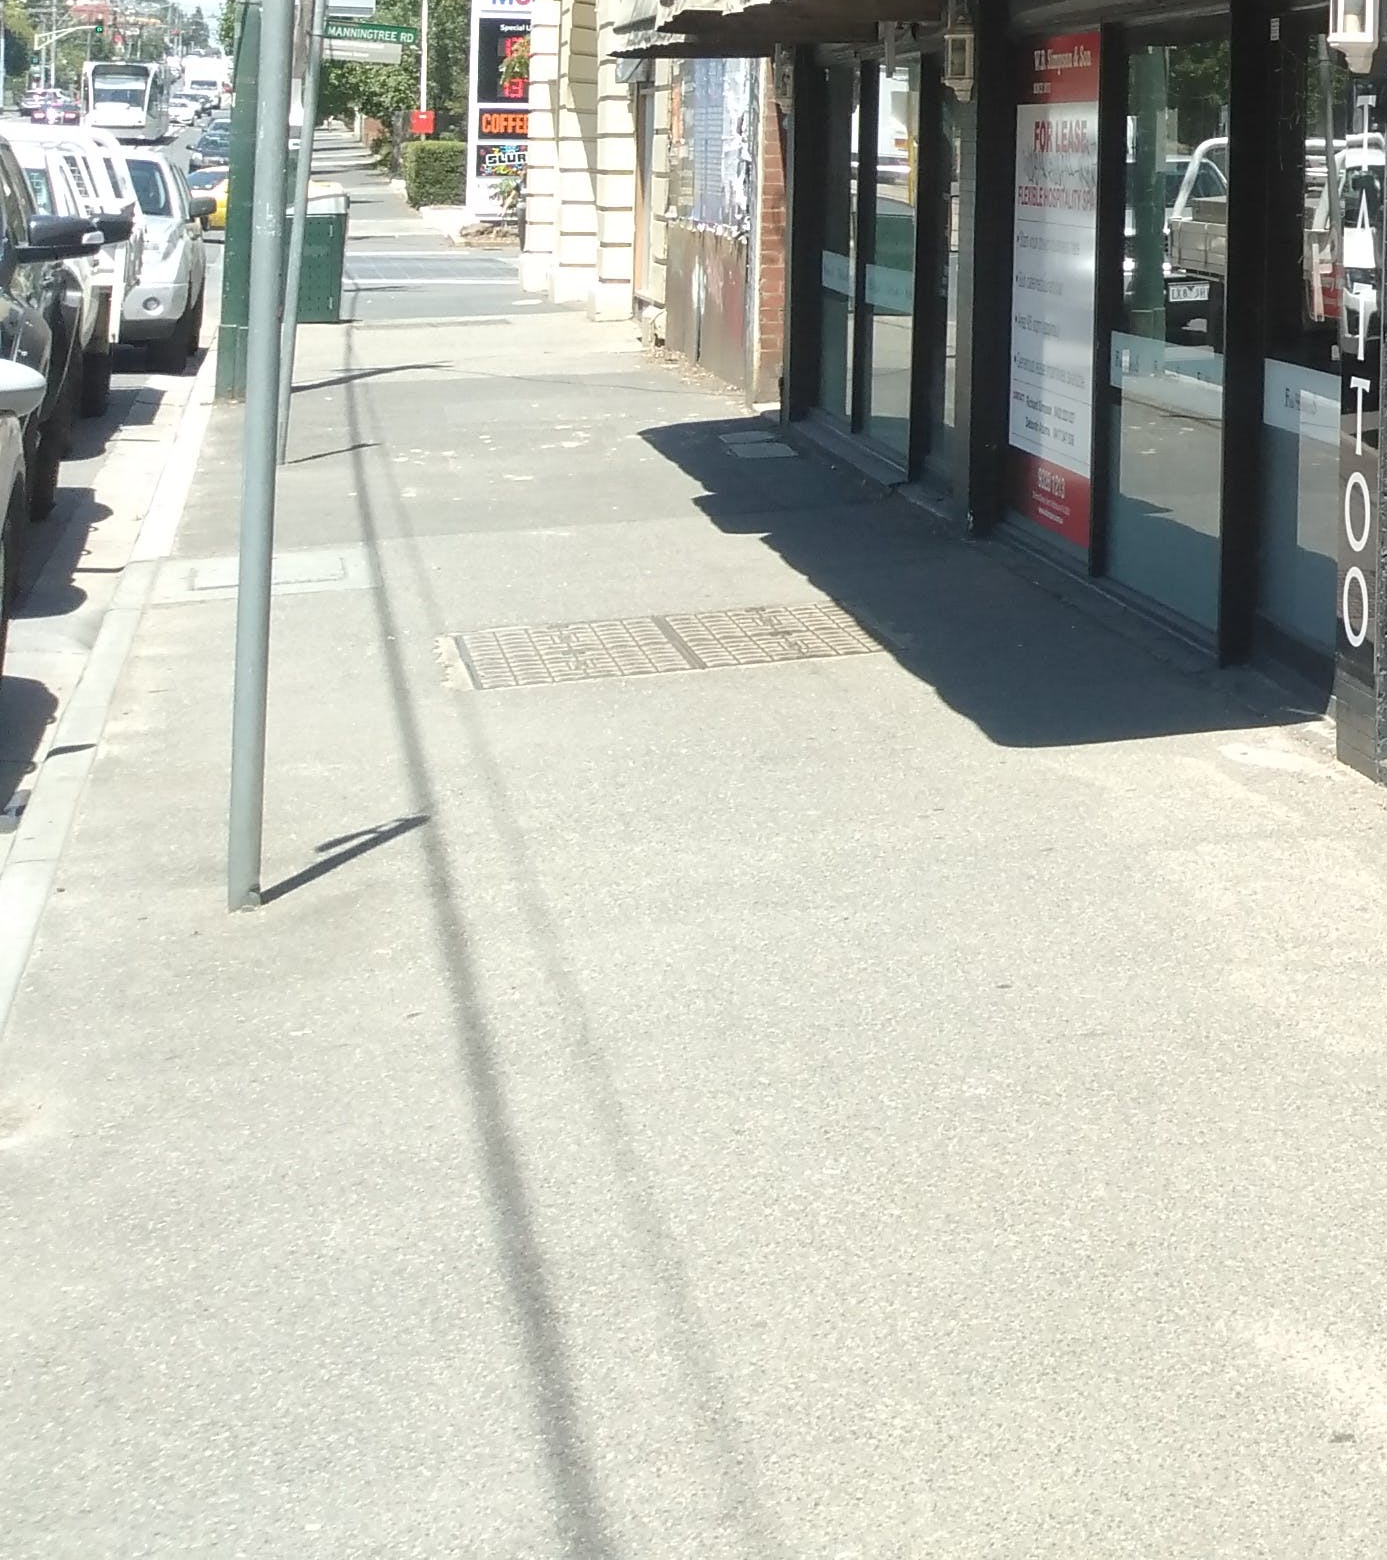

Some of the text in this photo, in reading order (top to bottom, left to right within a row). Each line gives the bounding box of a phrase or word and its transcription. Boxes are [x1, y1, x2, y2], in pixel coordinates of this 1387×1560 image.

[328, 26, 414, 43] MANNINGTREE RD
[1033, 119, 1087, 153] FOR LEASE
